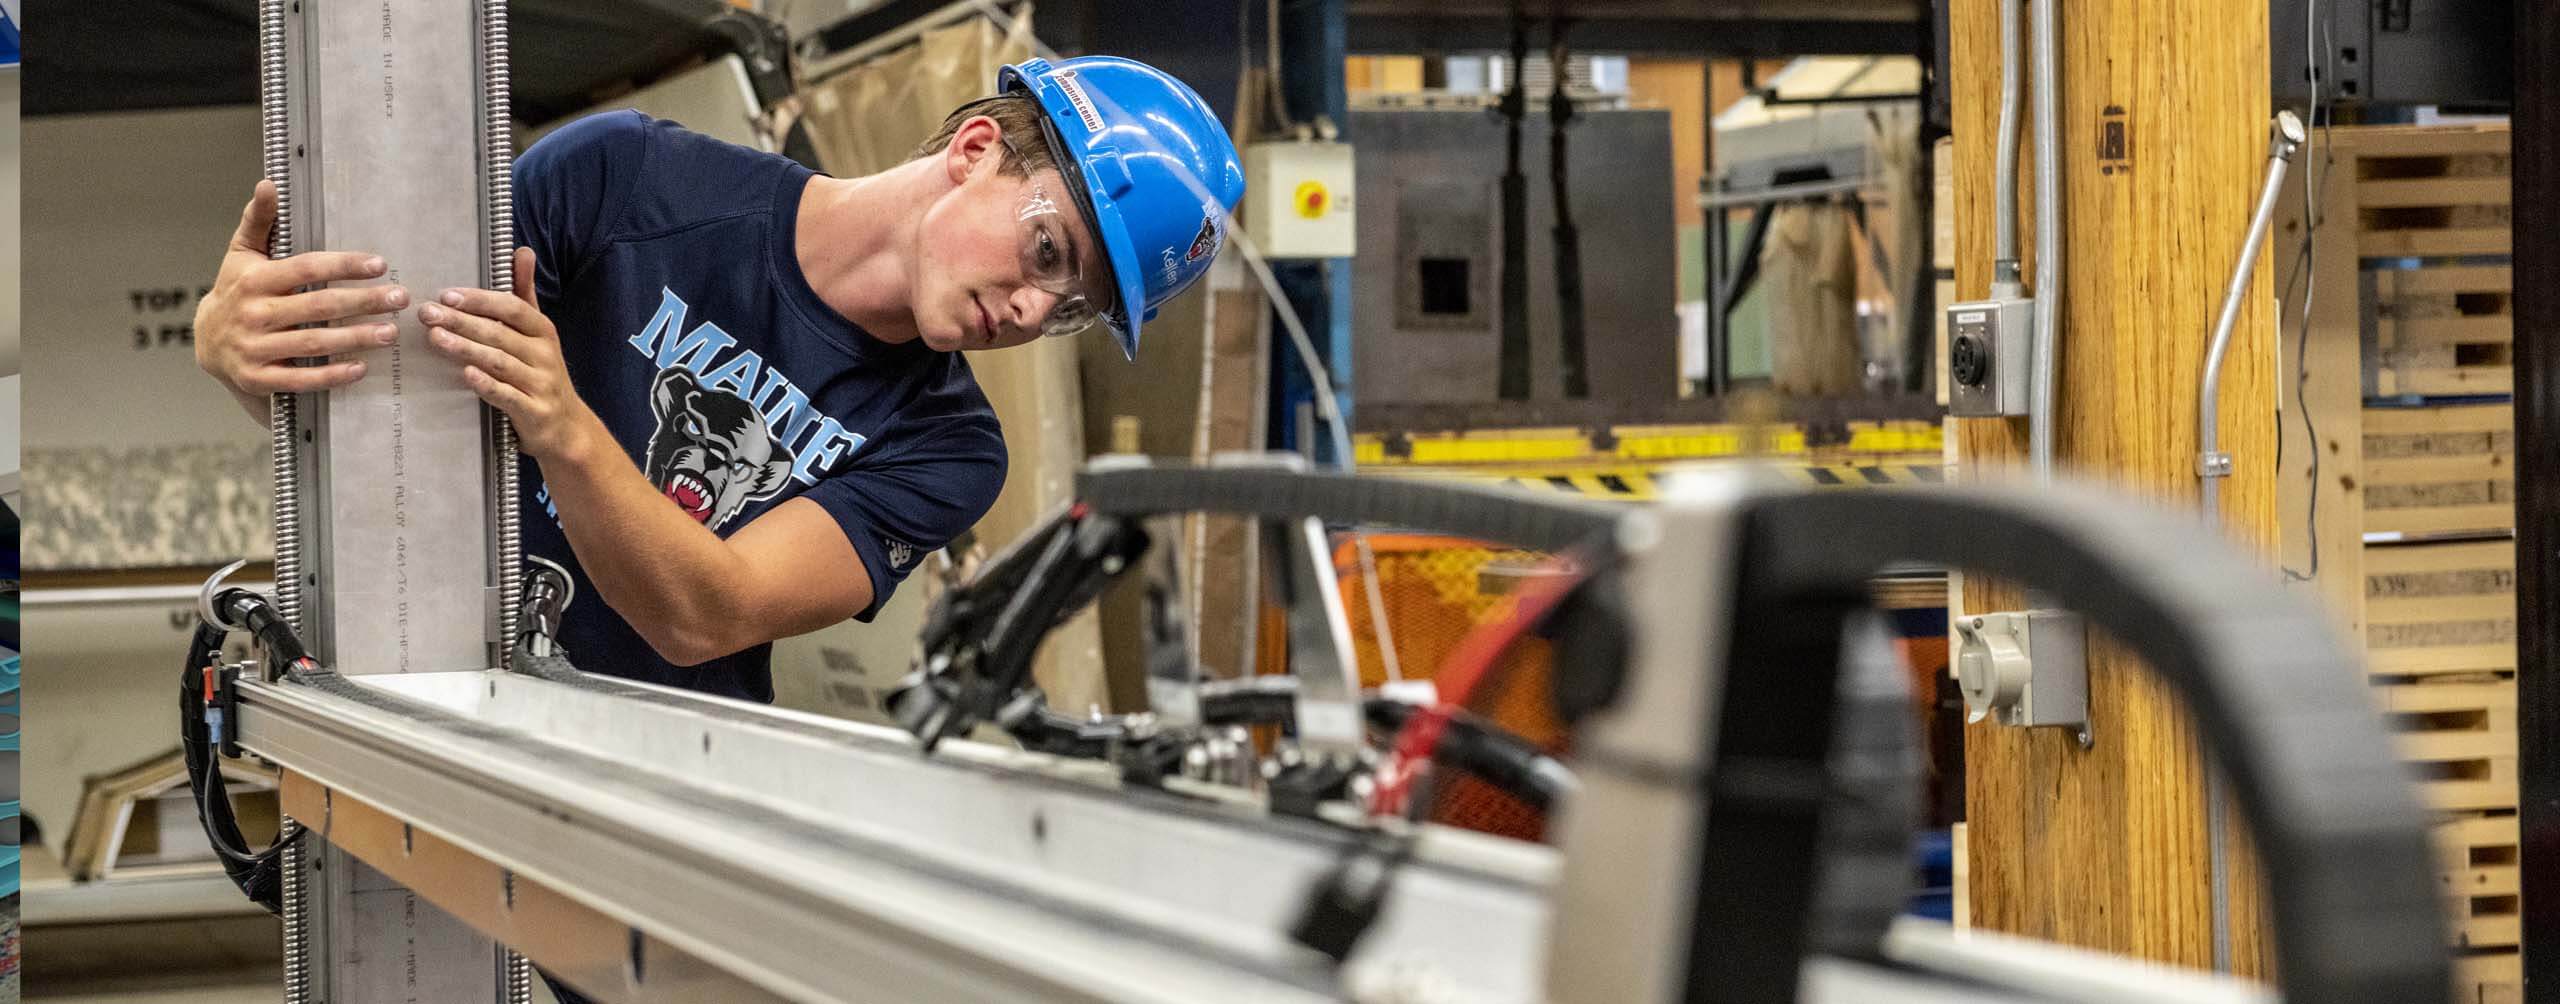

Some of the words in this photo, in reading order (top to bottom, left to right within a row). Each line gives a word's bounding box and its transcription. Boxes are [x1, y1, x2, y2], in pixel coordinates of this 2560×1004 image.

[384, 51, 393, 68] IN
[1079, 105, 1098, 130] center
[1161, 246, 1178, 286] Kellen
[131, 289, 189, 312] TOP
[627, 285, 868, 488] MAINE
[395, 485, 406, 527] ALLOY
